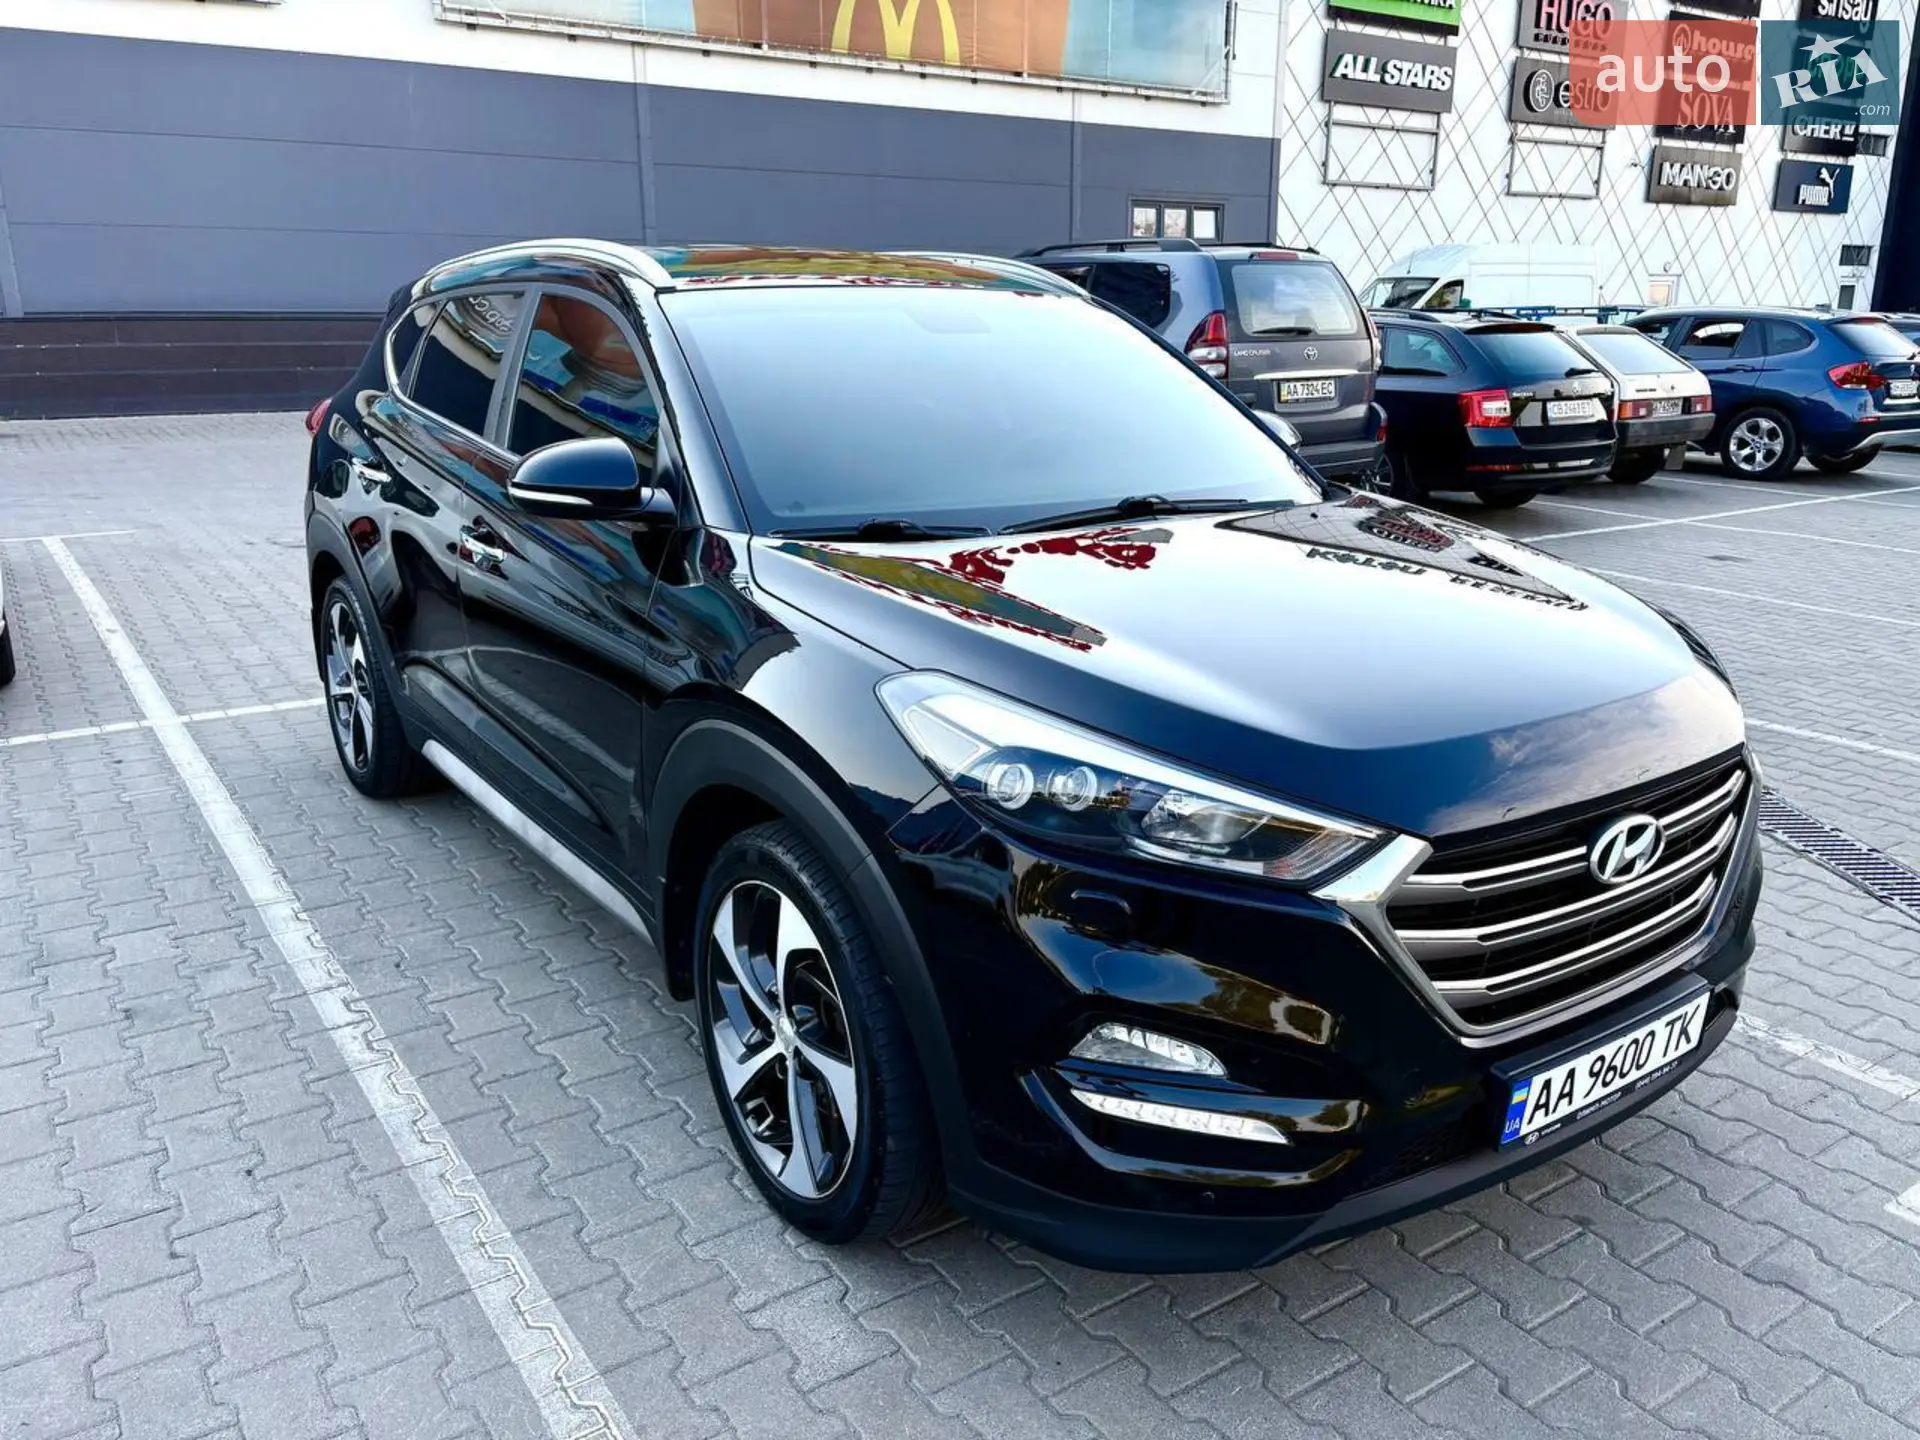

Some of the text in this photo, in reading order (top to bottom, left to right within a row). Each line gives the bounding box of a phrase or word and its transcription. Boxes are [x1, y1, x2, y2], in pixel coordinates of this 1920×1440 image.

[1535, 0, 1613, 39] HUGO
[1332, 53, 1453, 91] ALL STARS
[1677, 91, 1736, 133] SOVA
[1659, 161, 1737, 191] MANGO
[1798, 184, 1830, 207] PUMA
[1527, 1067, 1576, 1125] AA
[1584, 1030, 1656, 1099] 9600
[1662, 1004, 1701, 1058] TK
[1505, 1117, 1520, 1133] UA
